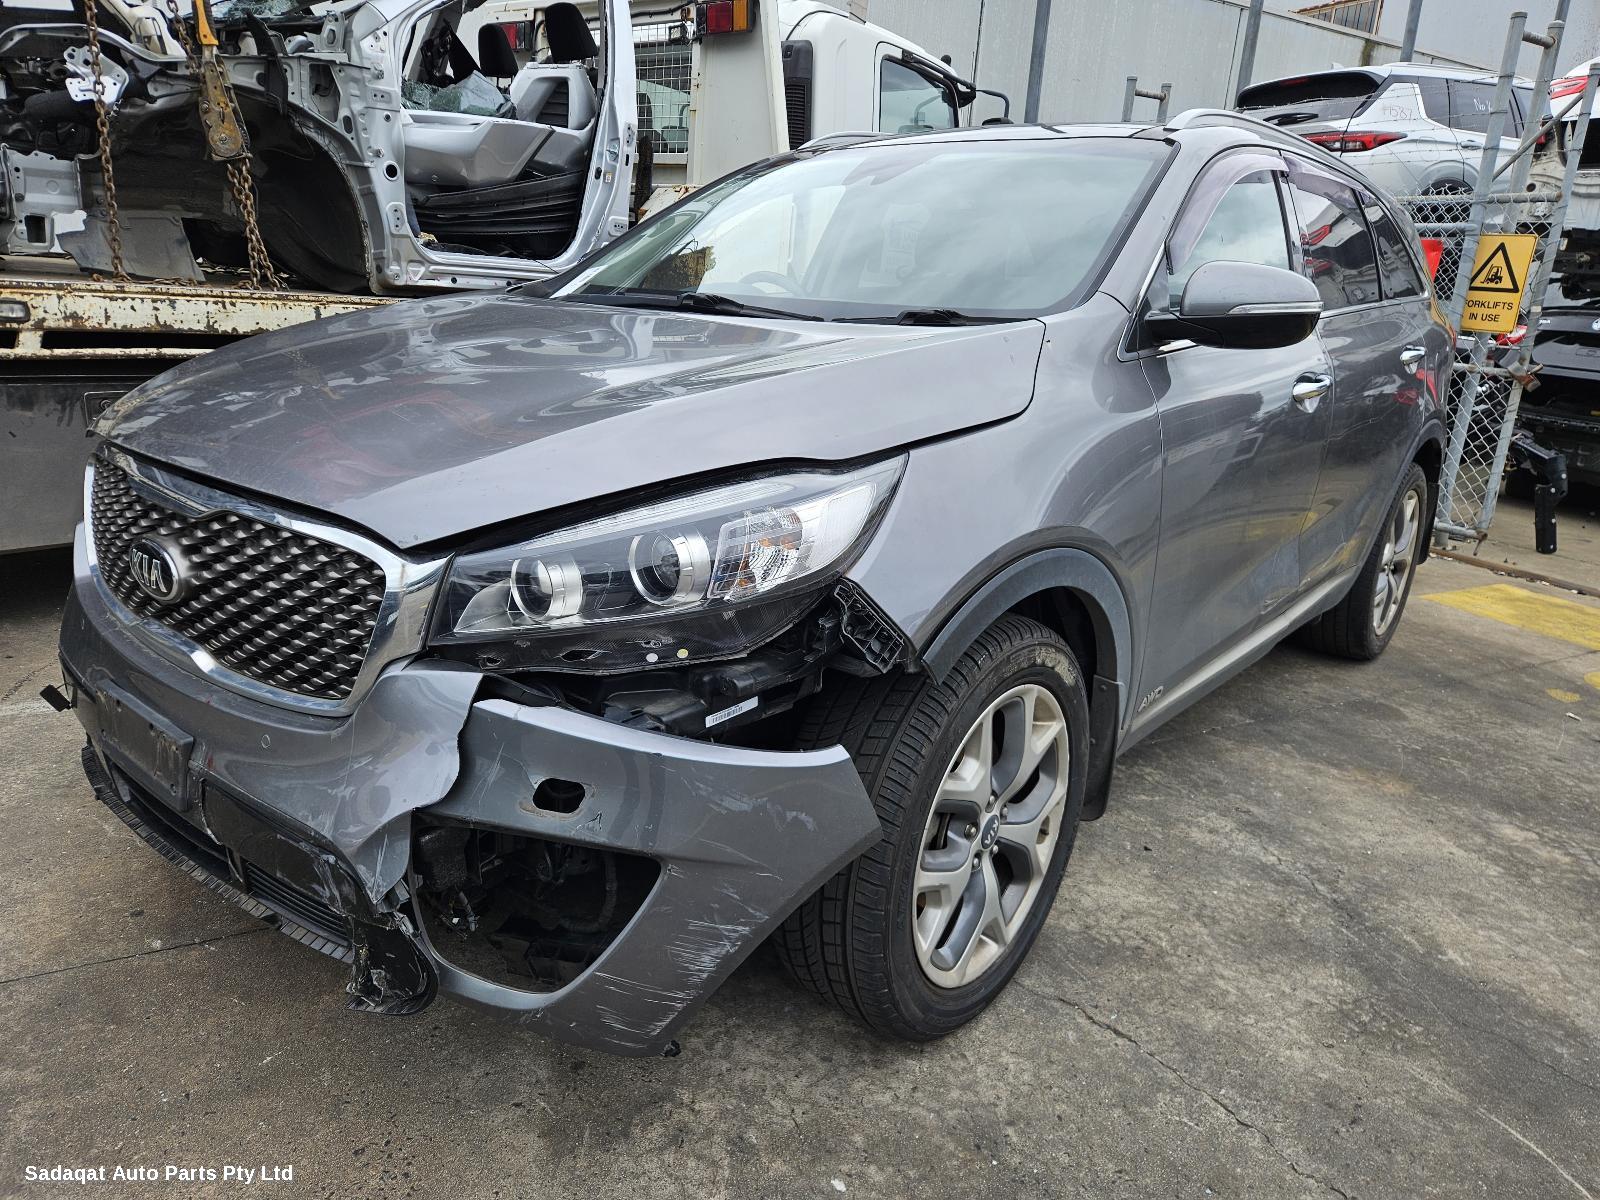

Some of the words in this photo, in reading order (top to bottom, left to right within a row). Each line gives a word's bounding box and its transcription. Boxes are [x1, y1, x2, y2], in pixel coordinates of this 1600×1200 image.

[1468, 312, 1478, 320] IN
[1481, 313, 1501, 322] USE
[131, 548, 168, 593] KIA
[984, 819, 999, 845] KIA
